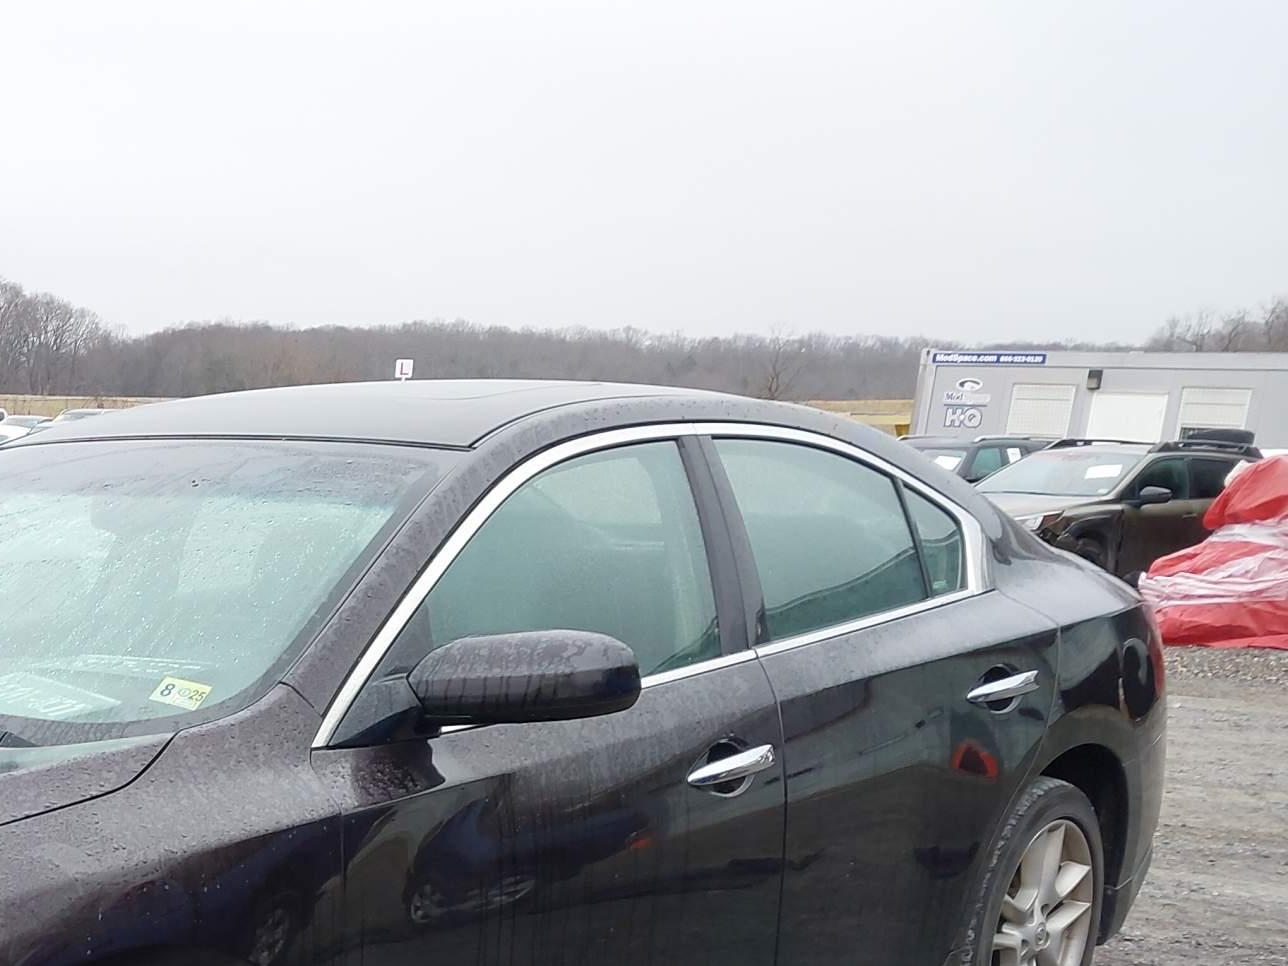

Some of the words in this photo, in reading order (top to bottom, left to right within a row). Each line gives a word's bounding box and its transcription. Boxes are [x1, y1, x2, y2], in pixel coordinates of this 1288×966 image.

[400, 362, 408, 375] L
[160, 683, 176, 697] 8
[188, 689, 207, 702] 25
